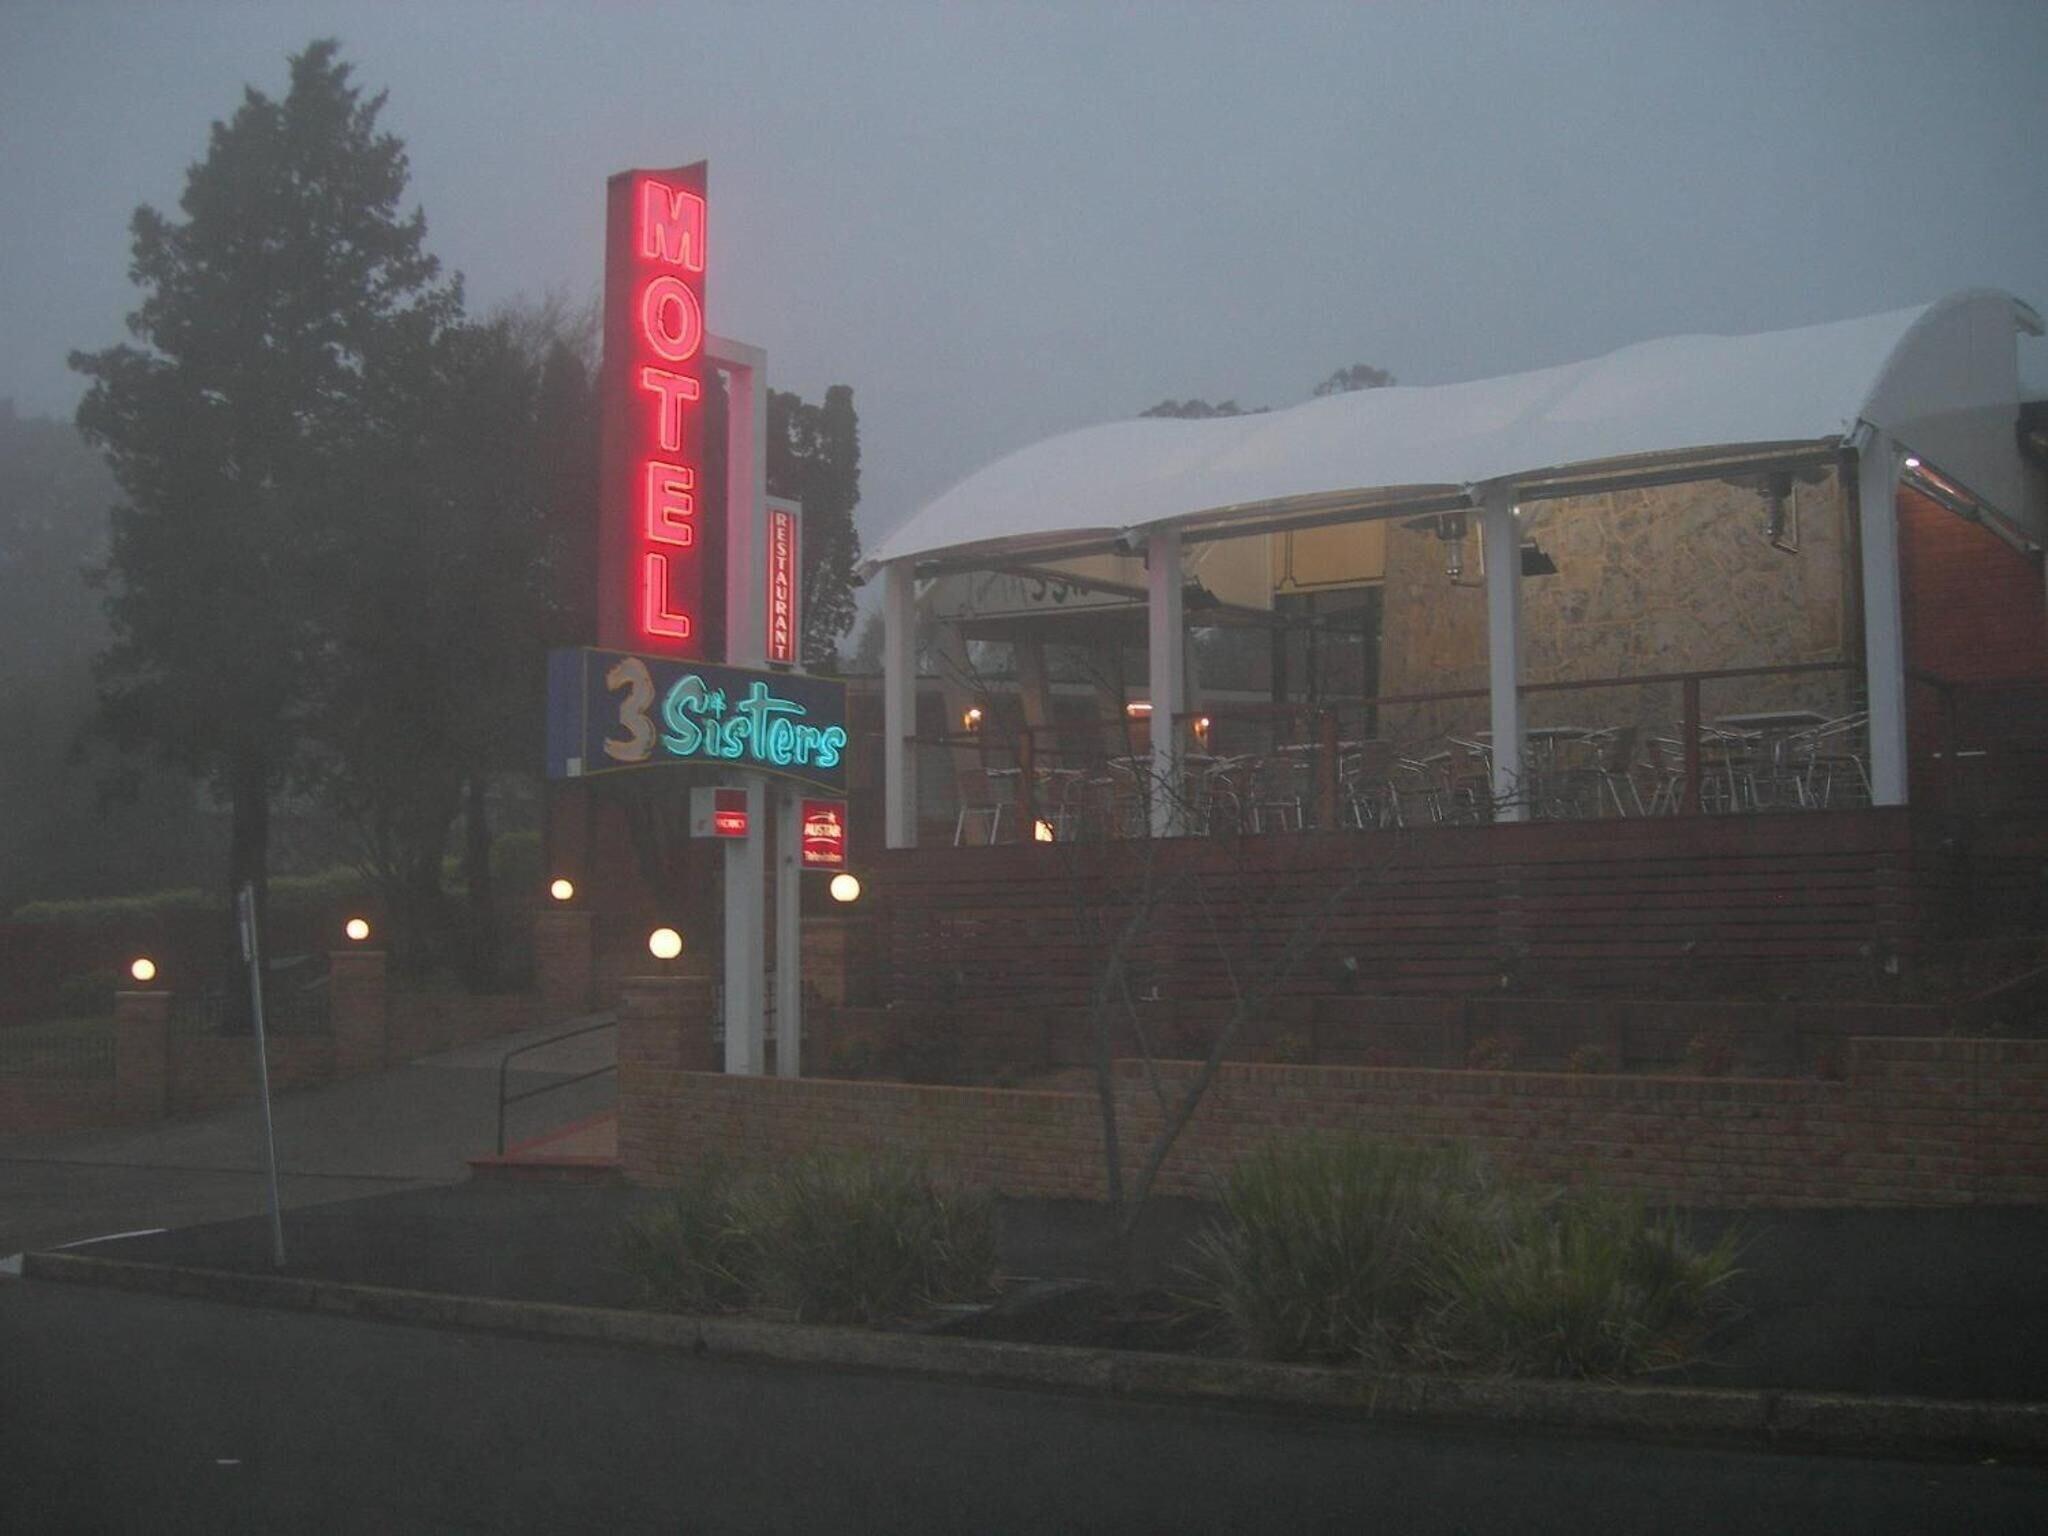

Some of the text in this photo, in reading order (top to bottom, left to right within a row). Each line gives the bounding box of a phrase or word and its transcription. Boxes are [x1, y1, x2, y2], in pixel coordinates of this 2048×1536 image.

[641, 179, 706, 639] MOTEL
[775, 512, 788, 660] RESTAURANT
[604, 656, 847, 768] 3 Sisters
